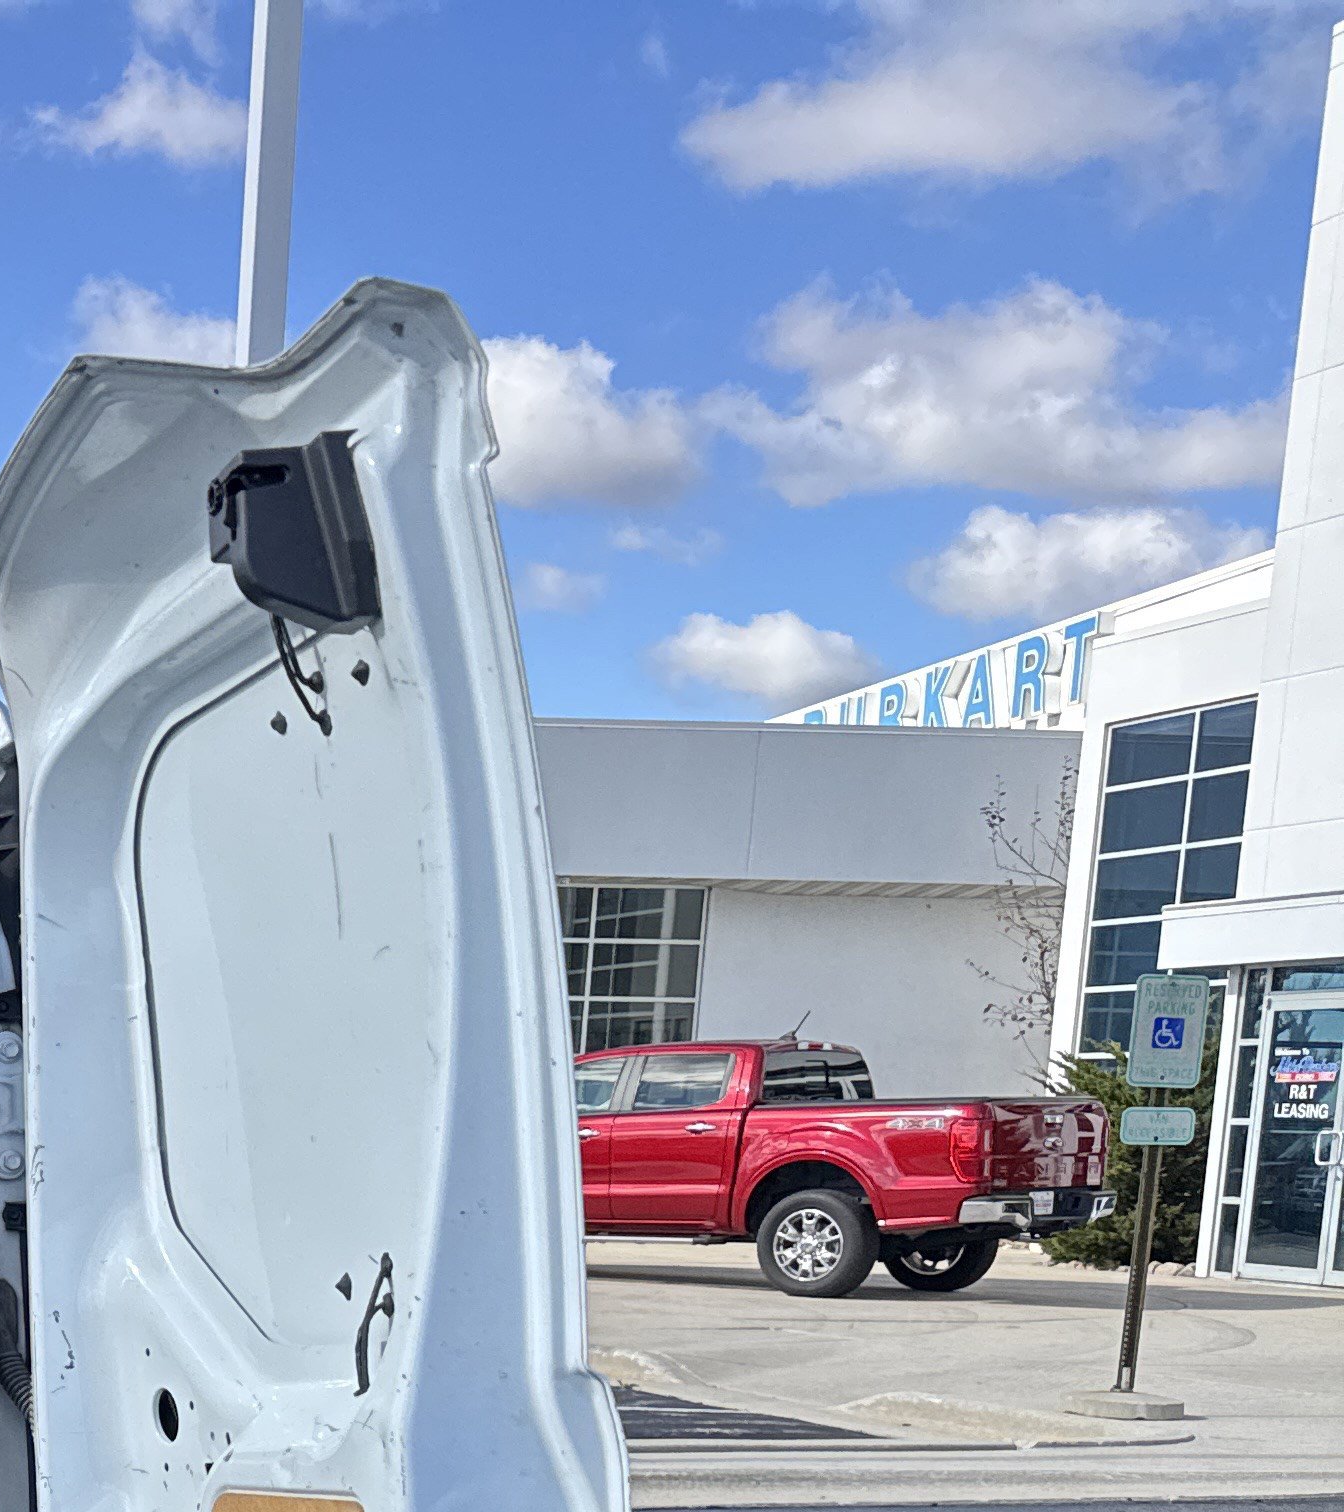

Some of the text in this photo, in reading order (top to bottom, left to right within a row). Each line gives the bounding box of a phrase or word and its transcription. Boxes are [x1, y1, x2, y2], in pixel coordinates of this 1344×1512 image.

[803, 616, 1097, 729] RKART
[1289, 1084, 1318, 1100] R&T
[1274, 1102, 1329, 1119] LEASING
